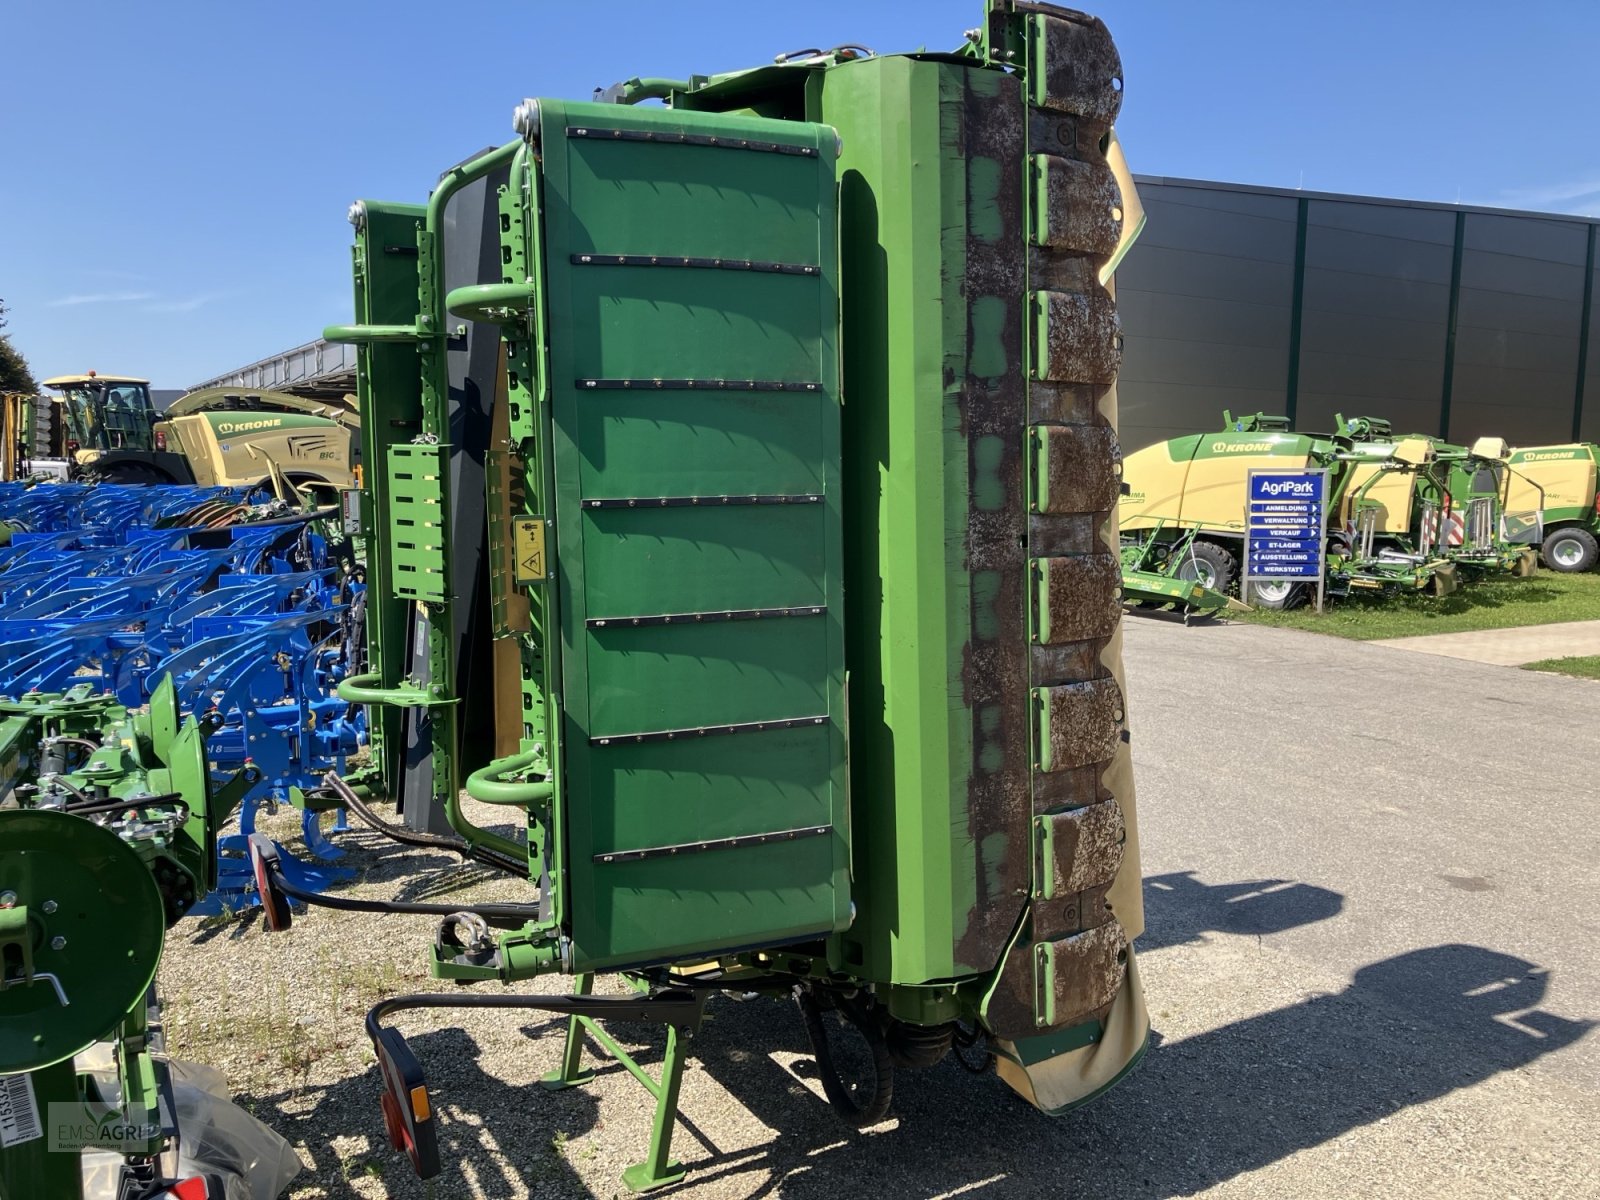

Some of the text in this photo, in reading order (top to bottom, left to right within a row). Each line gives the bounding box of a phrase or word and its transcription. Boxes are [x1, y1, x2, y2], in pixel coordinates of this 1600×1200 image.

[235, 419, 281, 432] KRONE
[1226, 443, 1273, 452] KRONE
[1535, 451, 1575, 460] KRONE
[1260, 481, 1314, 495] AgriPark
[215, 745, 222, 753] 8
